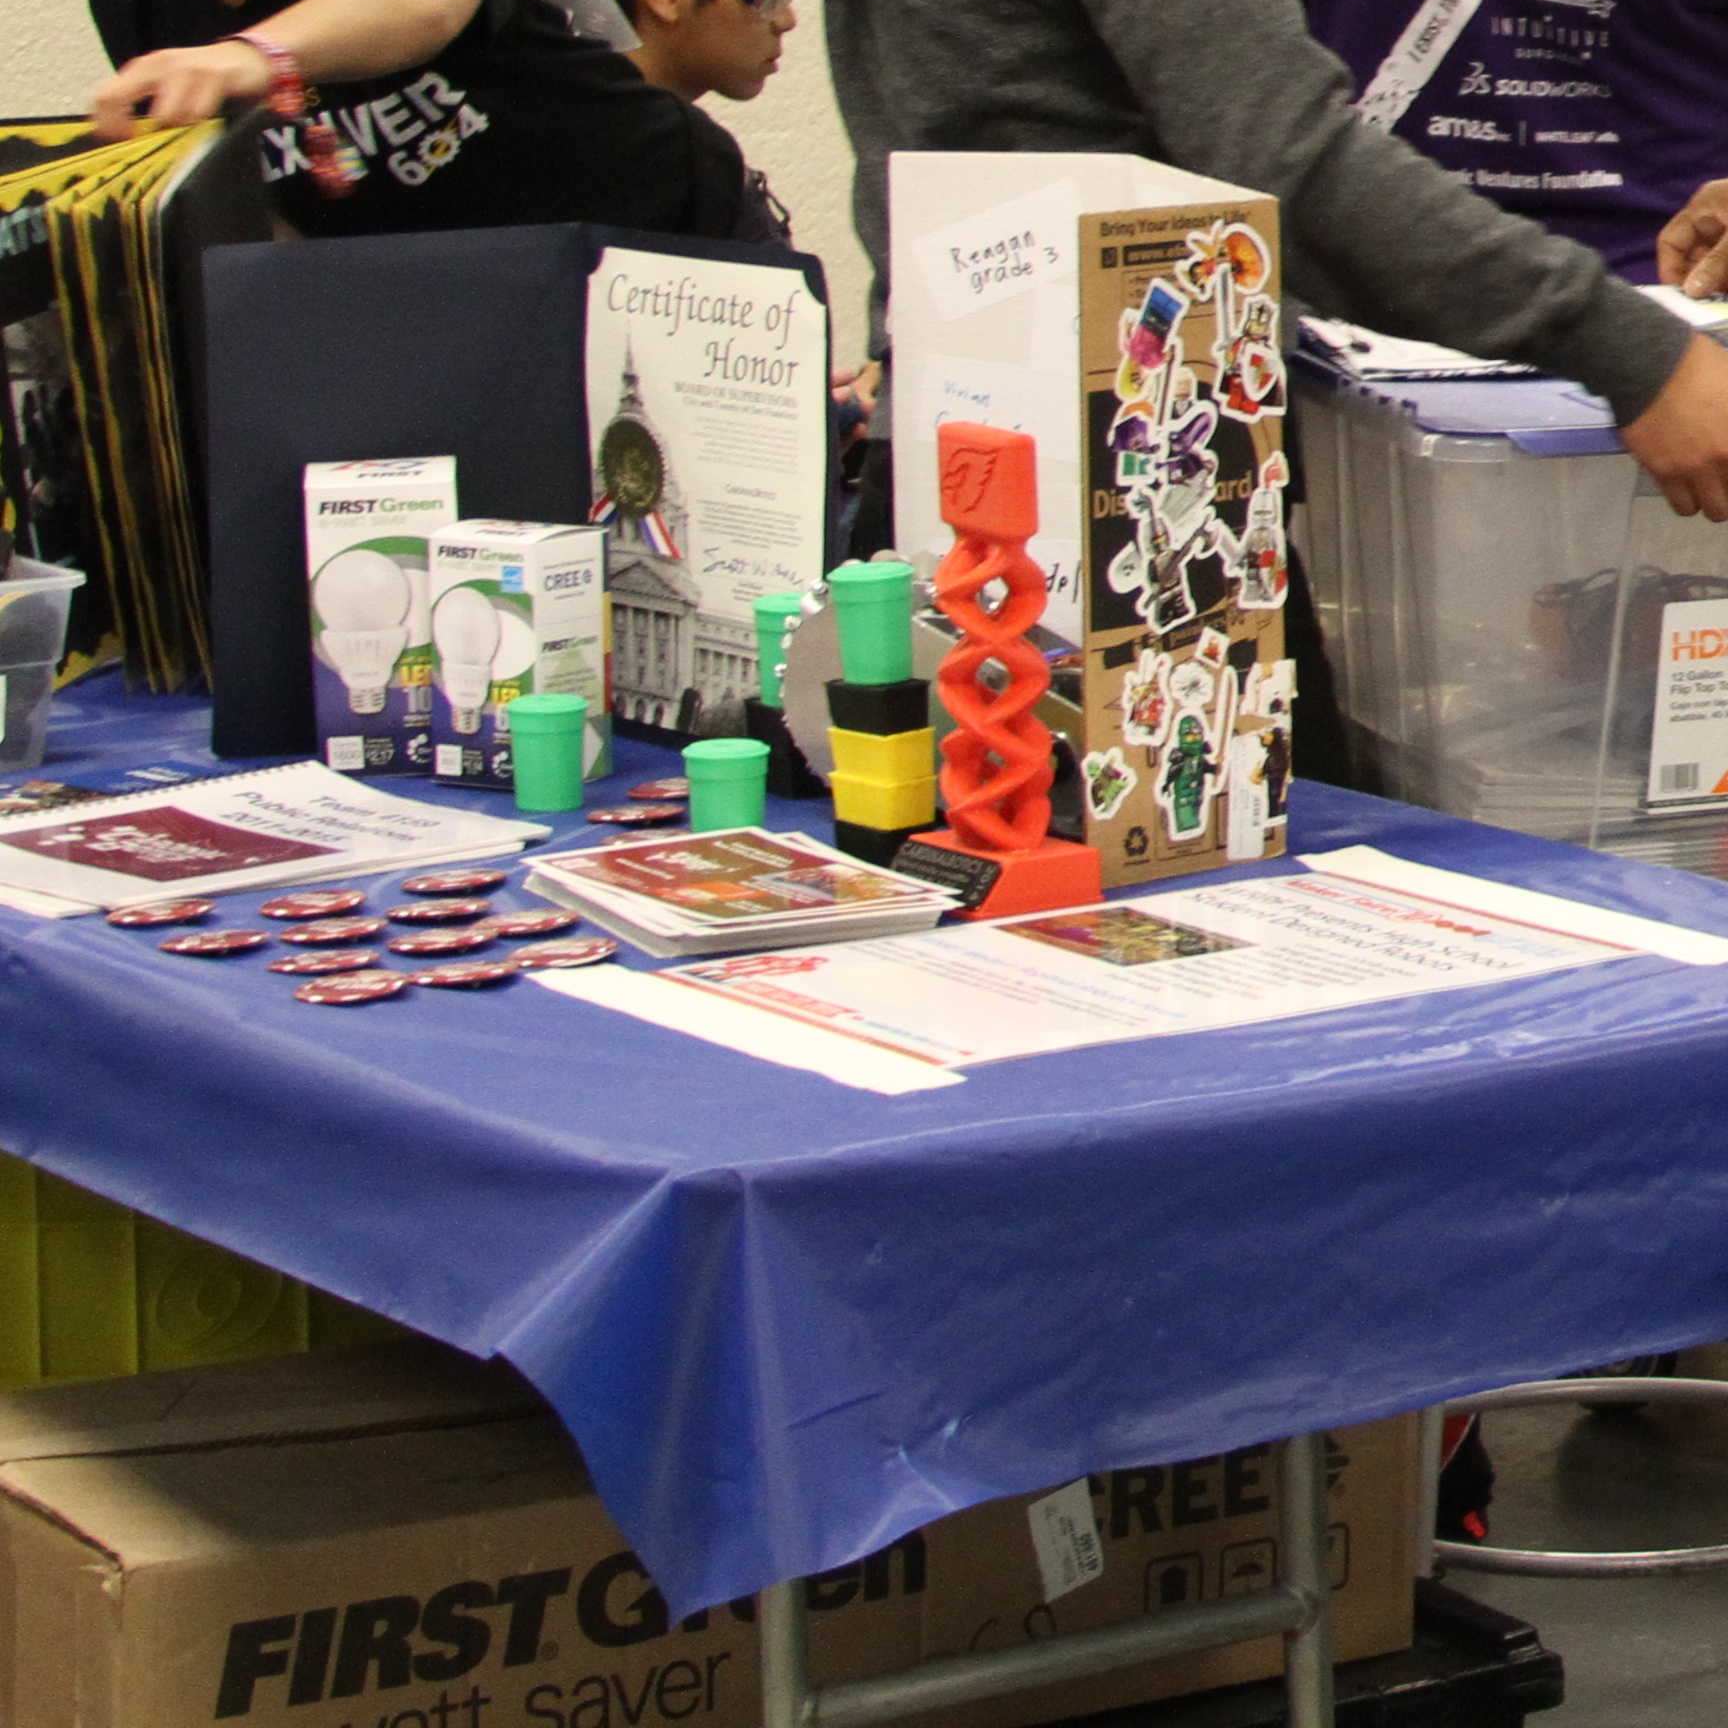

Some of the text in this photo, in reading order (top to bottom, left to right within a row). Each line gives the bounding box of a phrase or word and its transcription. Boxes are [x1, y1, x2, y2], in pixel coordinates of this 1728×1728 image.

[387, 103, 490, 187] 604
[950, 229, 1036, 273] Reagan
[970, 246, 1059, 294] grade 3
[607, 273, 801, 351] Certificate of
[703, 337, 799, 388] Honor
[318, 498, 444, 515] FIRST Green
[437, 545, 524, 562] FIRST Green
[544, 569, 581, 592] CREE
[1670, 683, 1692, 696] Flip
[1695, 681, 1717, 694] Top
[1686, 670, 1724, 682] Gallon
[1088, 1443, 1270, 1540] REE
[215, 1566, 574, 1719] FIRST
[524, 1649, 732, 1728] saver
